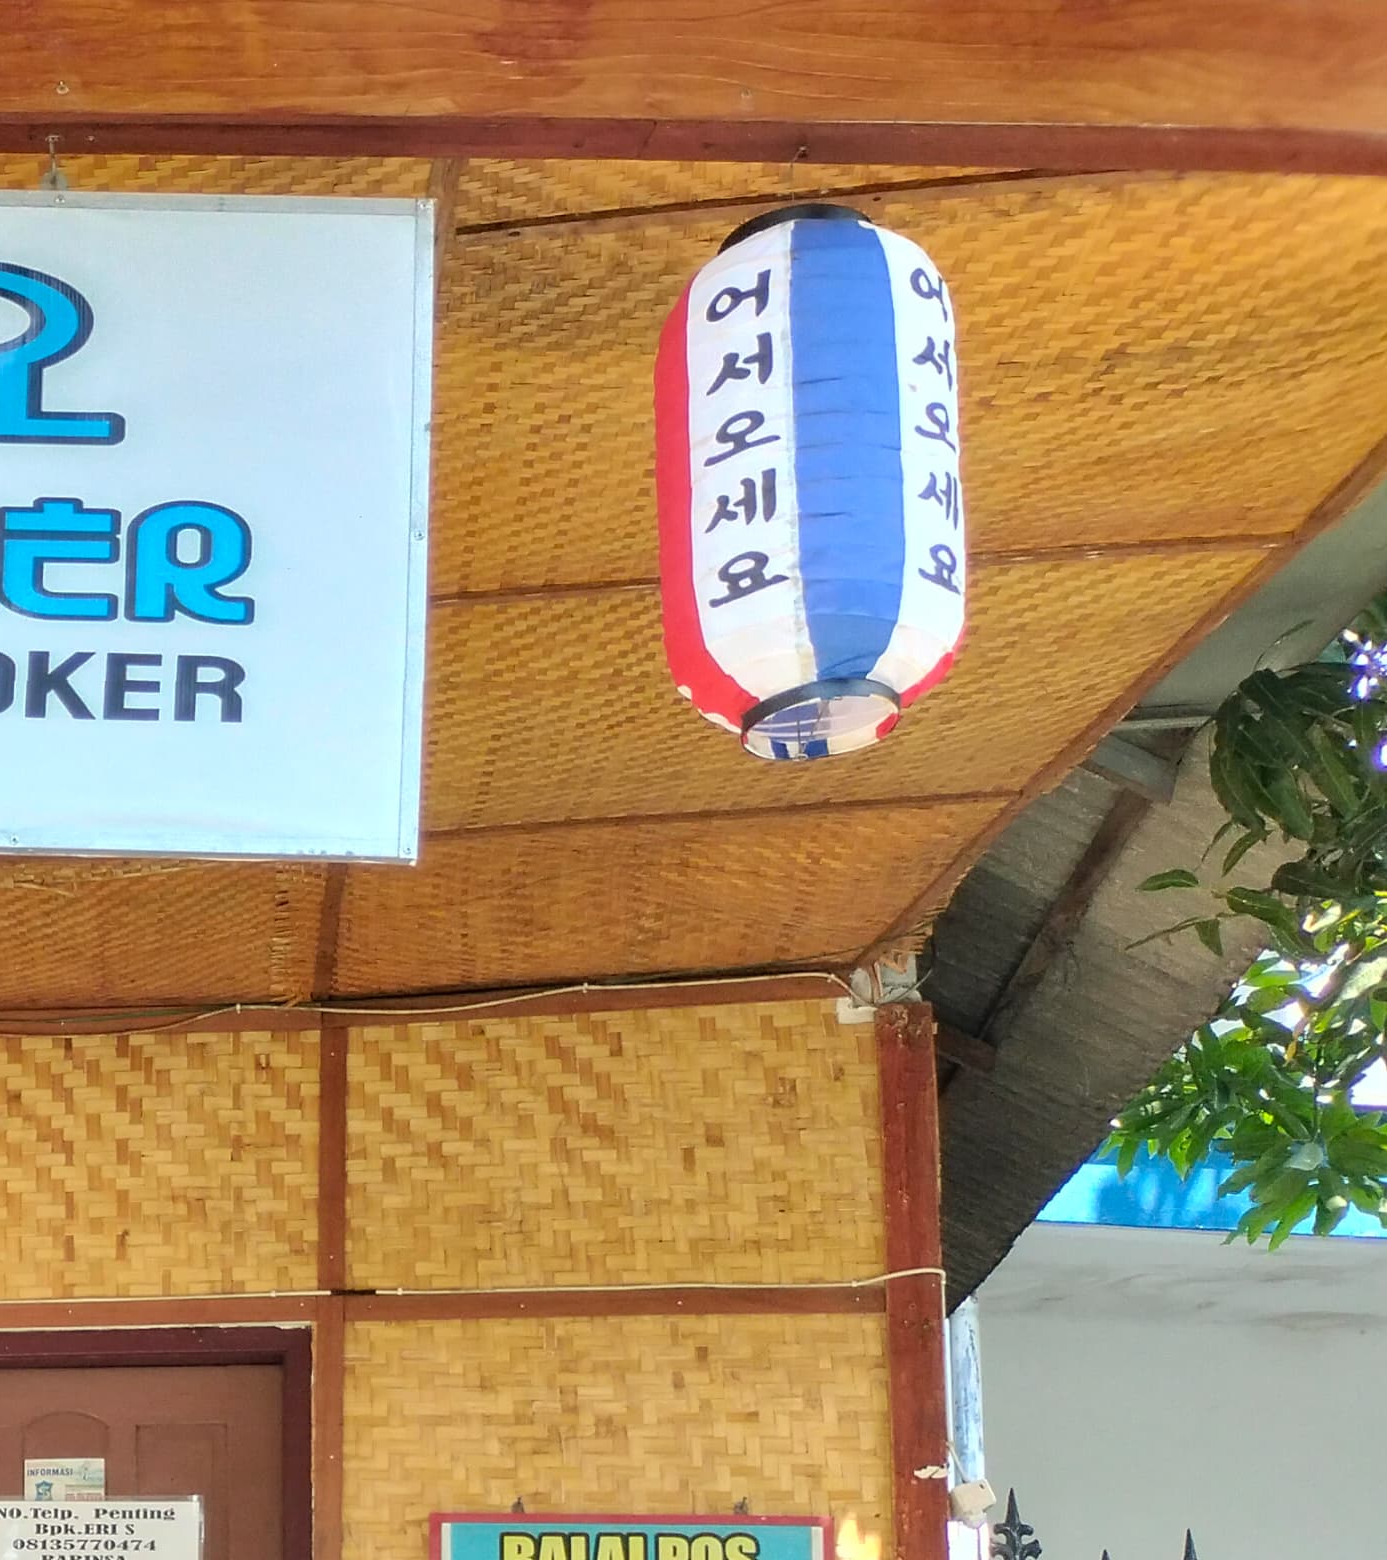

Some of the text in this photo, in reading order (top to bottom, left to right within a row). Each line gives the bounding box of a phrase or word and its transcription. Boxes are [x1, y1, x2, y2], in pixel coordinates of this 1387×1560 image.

[704, 268, 789, 608] 어서오세요
[27, 1467, 73, 1477] INFORMASI
[94, 1508, 176, 1521] Penting
[13, 1539, 157, 1551] 08135770474
